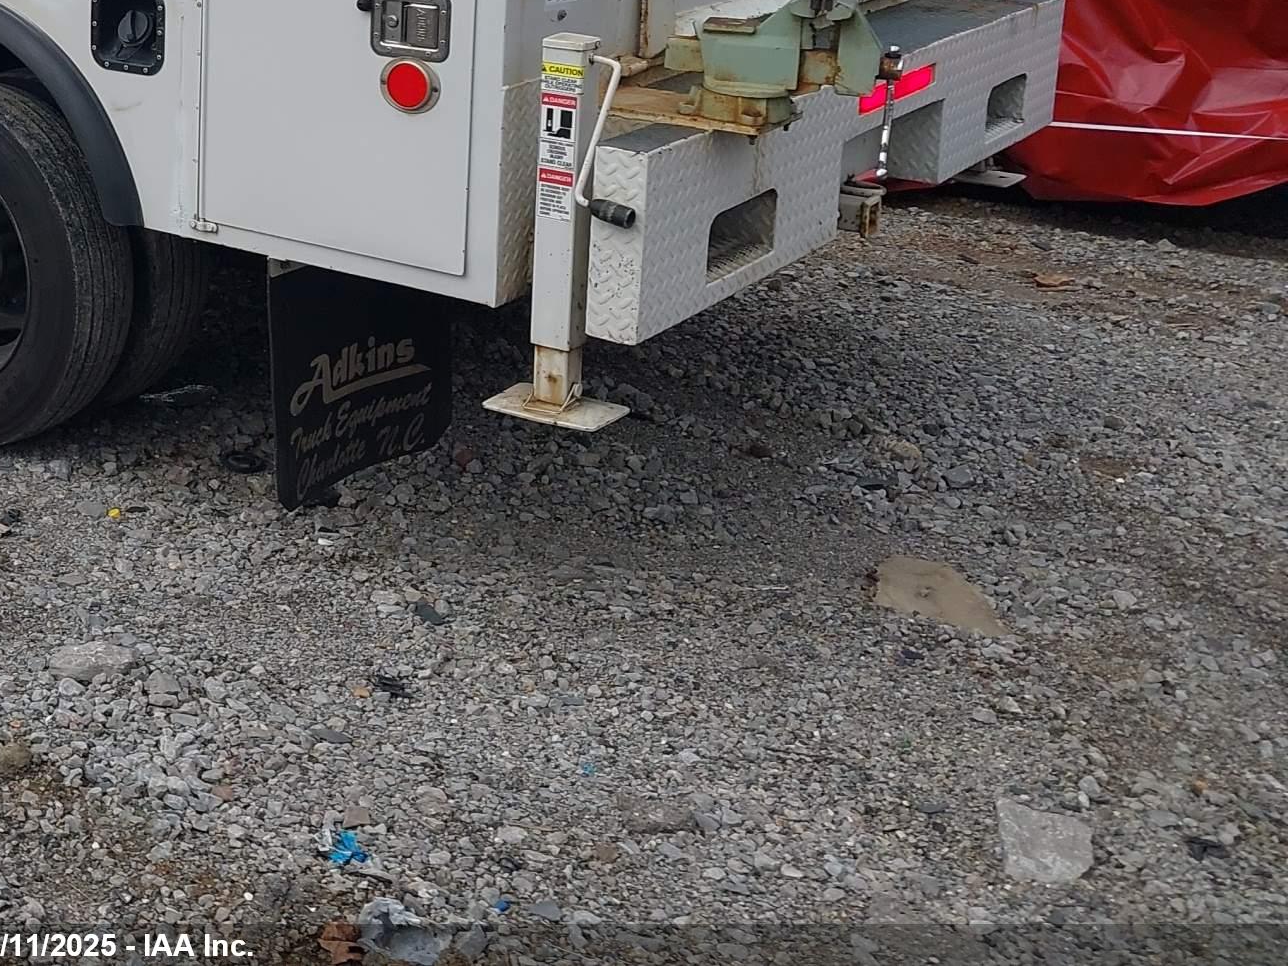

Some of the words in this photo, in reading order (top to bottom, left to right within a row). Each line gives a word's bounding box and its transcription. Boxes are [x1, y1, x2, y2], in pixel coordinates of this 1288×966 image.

[549, 65, 584, 76] CAUTION
[290, 336, 416, 417] Adkins
[290, 411, 333, 459] Truck
[335, 381, 433, 439] Equipment
[297, 438, 367, 501] Charlotte
